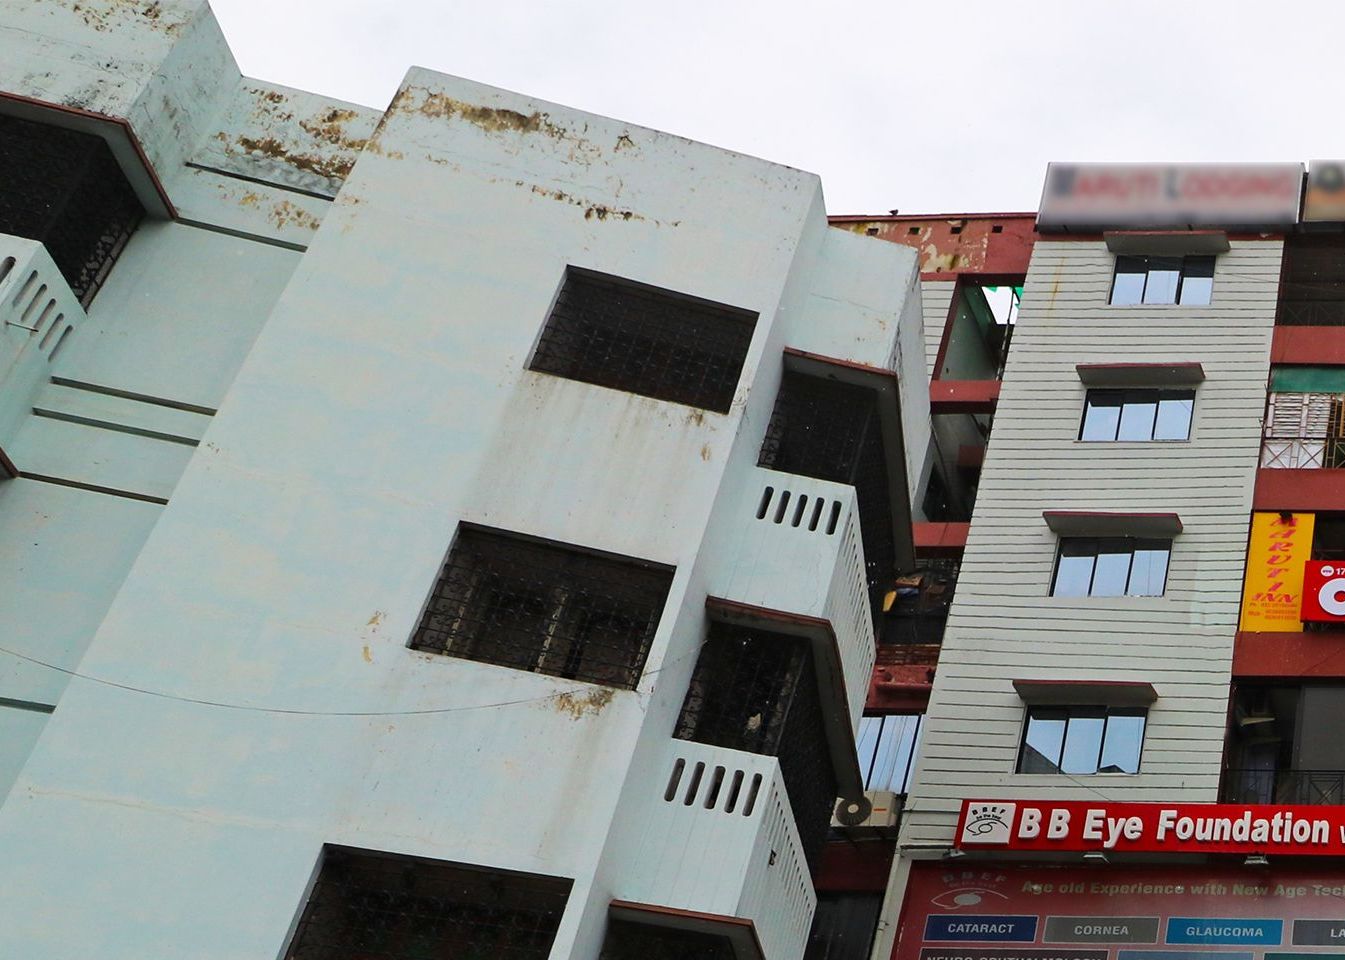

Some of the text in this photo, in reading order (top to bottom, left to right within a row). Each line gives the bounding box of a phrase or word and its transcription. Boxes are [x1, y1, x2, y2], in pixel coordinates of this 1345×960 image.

[1082, 809, 1144, 848] Eye
[1156, 810, 1330, 844] Foundation
[1022, 880, 1054, 896] Age
[1059, 881, 1085, 894] old
[1090, 883, 1185, 896] Experience
[1190, 884, 1227, 895] with
[1232, 884, 1268, 895] New
[1274, 885, 1307, 898] Age
[947, 923, 1015, 934] CATARACT
[1074, 925, 1130, 936] CORNEA
[1185, 926, 1264, 938] GLAUCOMA
